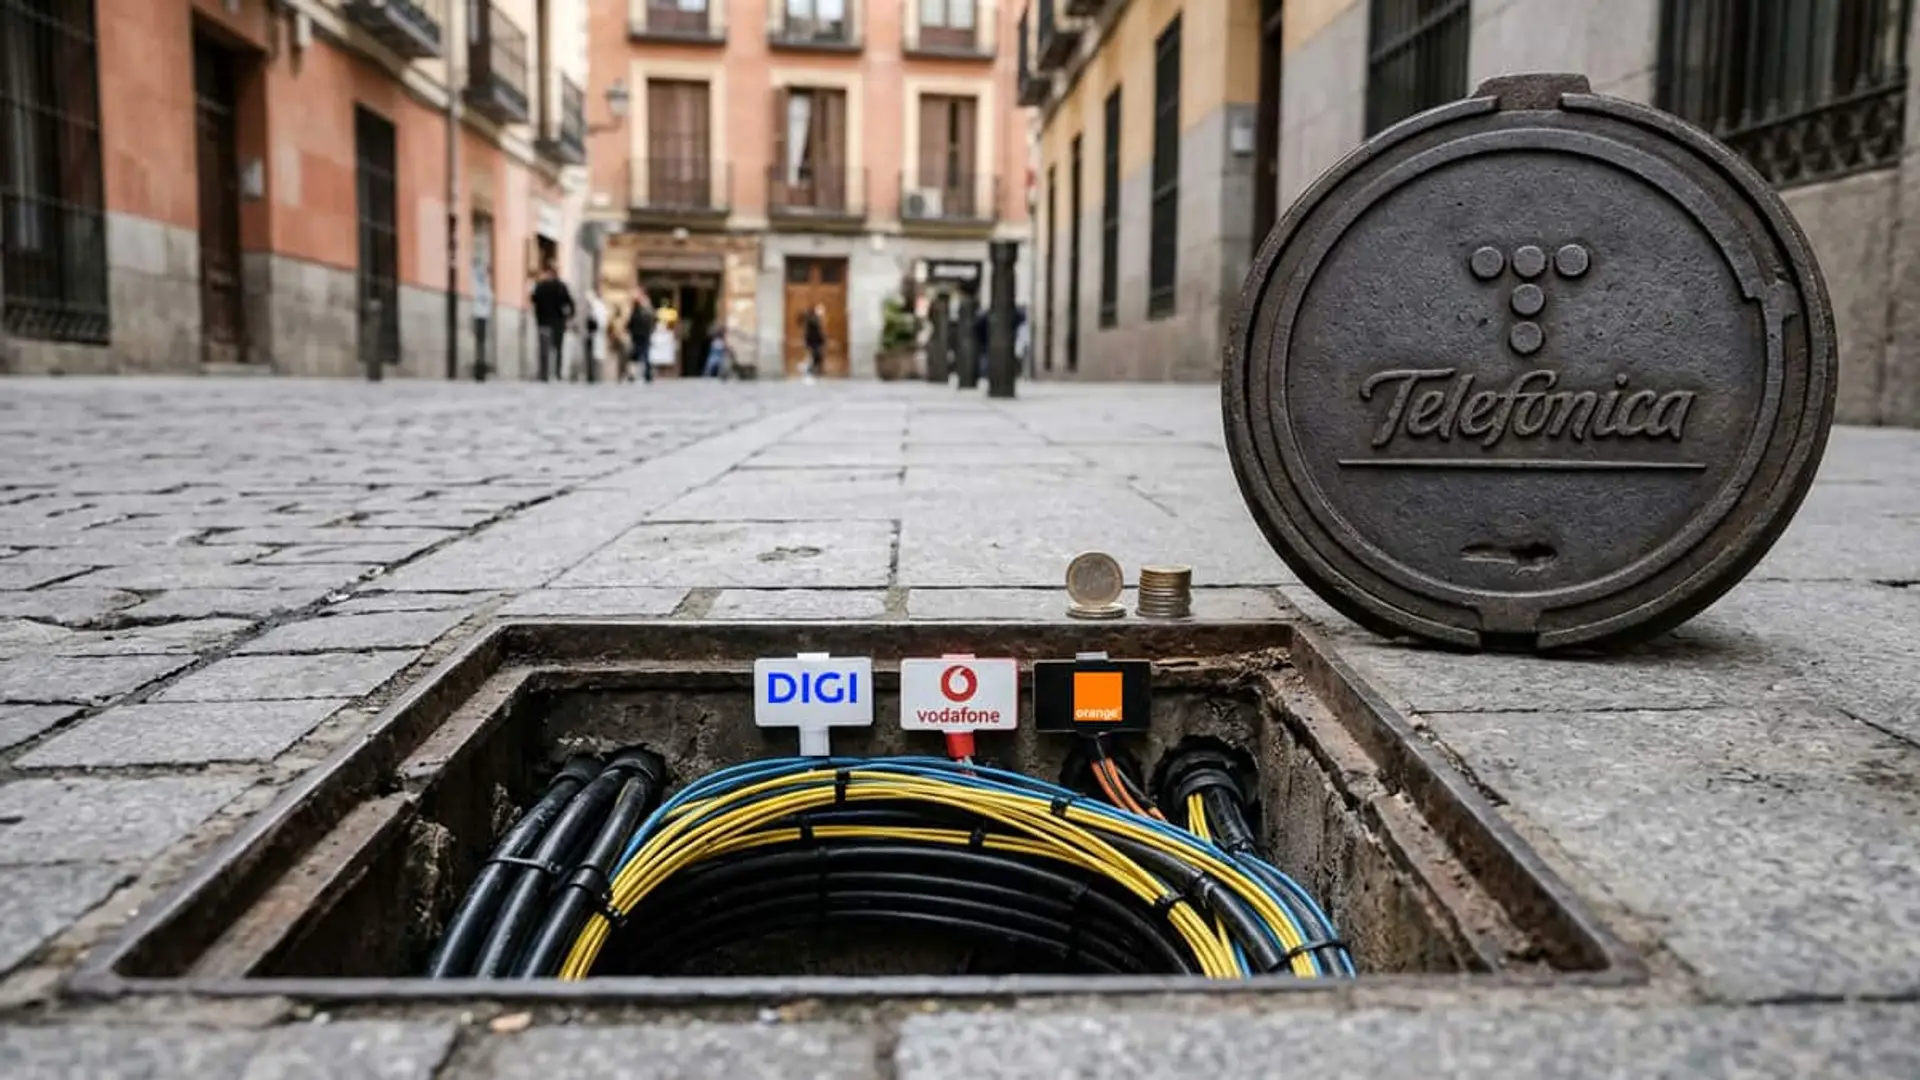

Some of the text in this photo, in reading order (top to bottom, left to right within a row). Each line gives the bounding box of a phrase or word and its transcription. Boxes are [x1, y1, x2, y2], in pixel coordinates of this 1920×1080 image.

[767, 672, 858, 704] DIGI
[916, 707, 1001, 724] vodafone
[1075, 708, 1117, 720] orange
